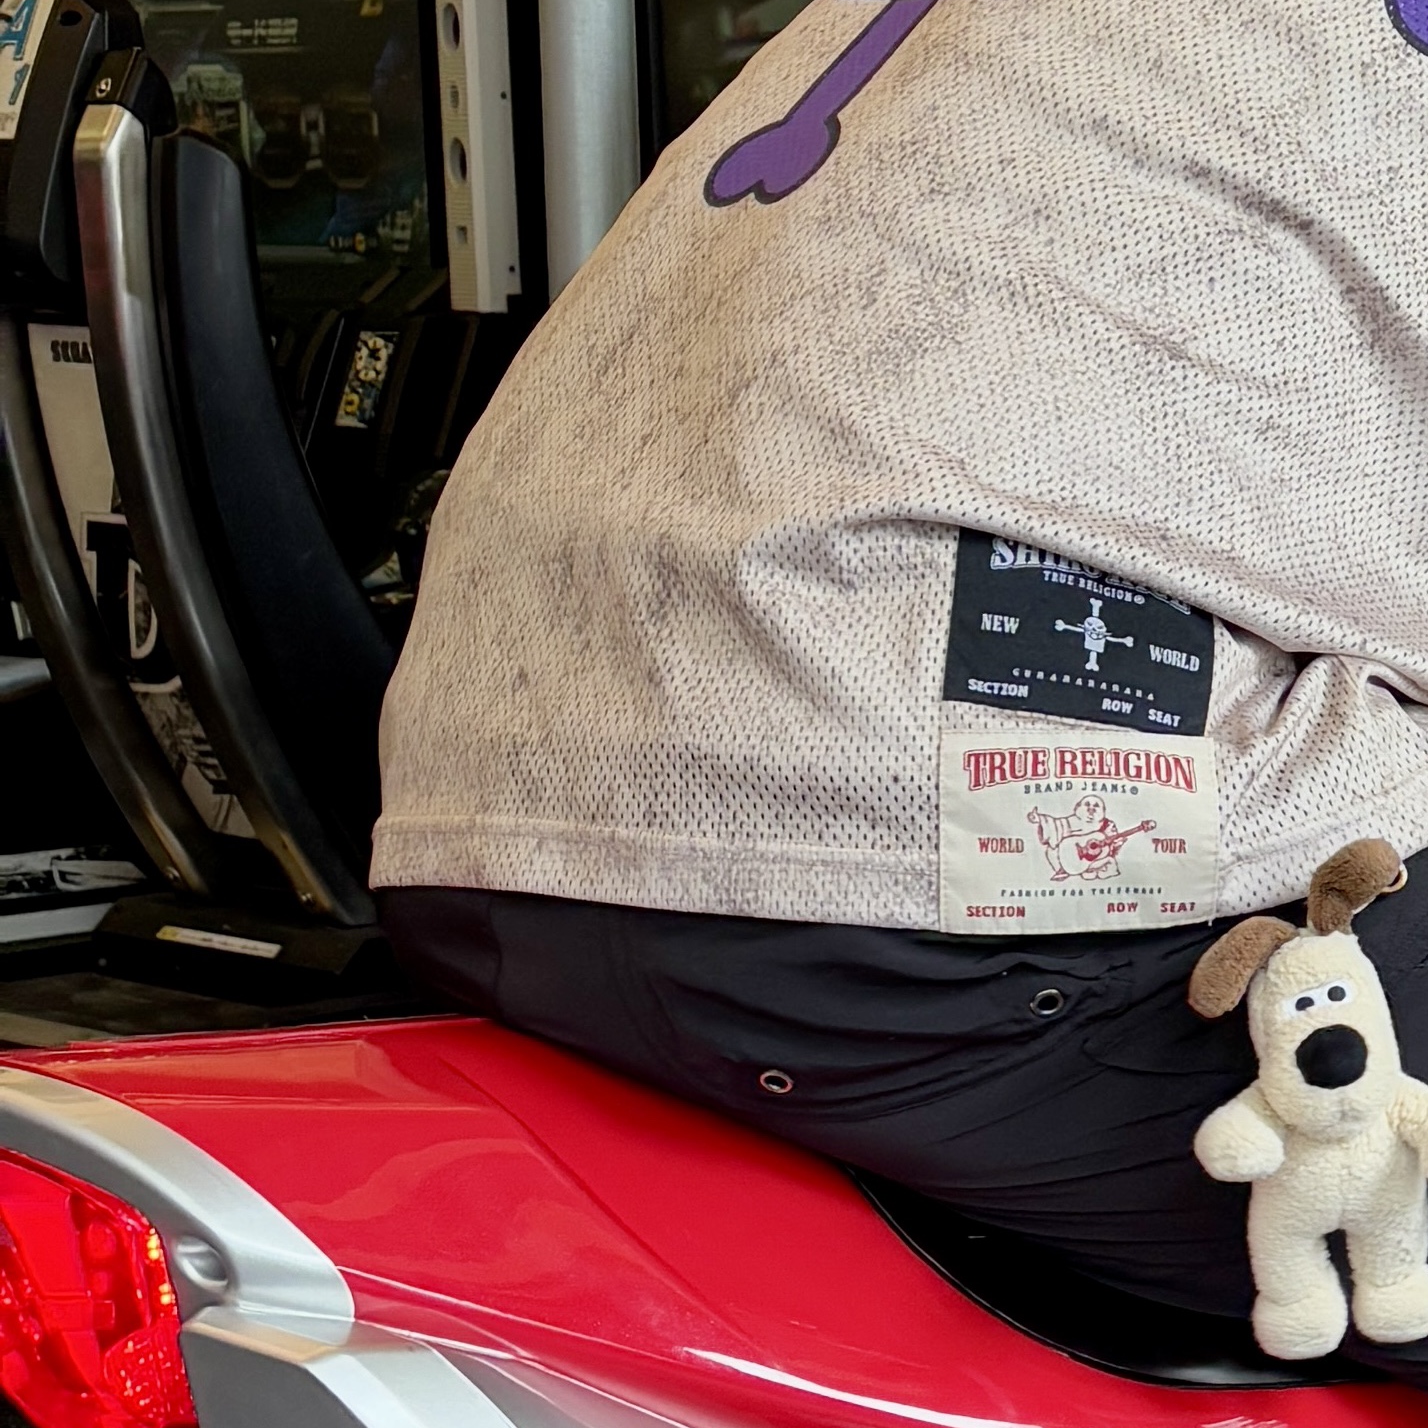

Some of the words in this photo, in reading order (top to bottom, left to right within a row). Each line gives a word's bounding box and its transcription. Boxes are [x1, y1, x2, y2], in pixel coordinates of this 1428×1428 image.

[1044, 571, 1075, 586] TRUE
[980, 613, 1020, 634] NEW
[1149, 644, 1201, 672] WORLD
[968, 678, 1029, 698] SECTION
[1102, 698, 1134, 715] ROW
[1148, 708, 1181, 727] SEAT
[963, 747, 1050, 792] TRUE
[1053, 746, 1197, 795] RELIGION
[1023, 781, 1074, 795] BRAND
[978, 837, 1025, 855] WORLD
[1152, 837, 1187, 855] TOUR
[966, 905, 1026, 918] SECTION
[1106, 901, 1139, 914] ROW
[1160, 901, 1196, 913] SEAT
